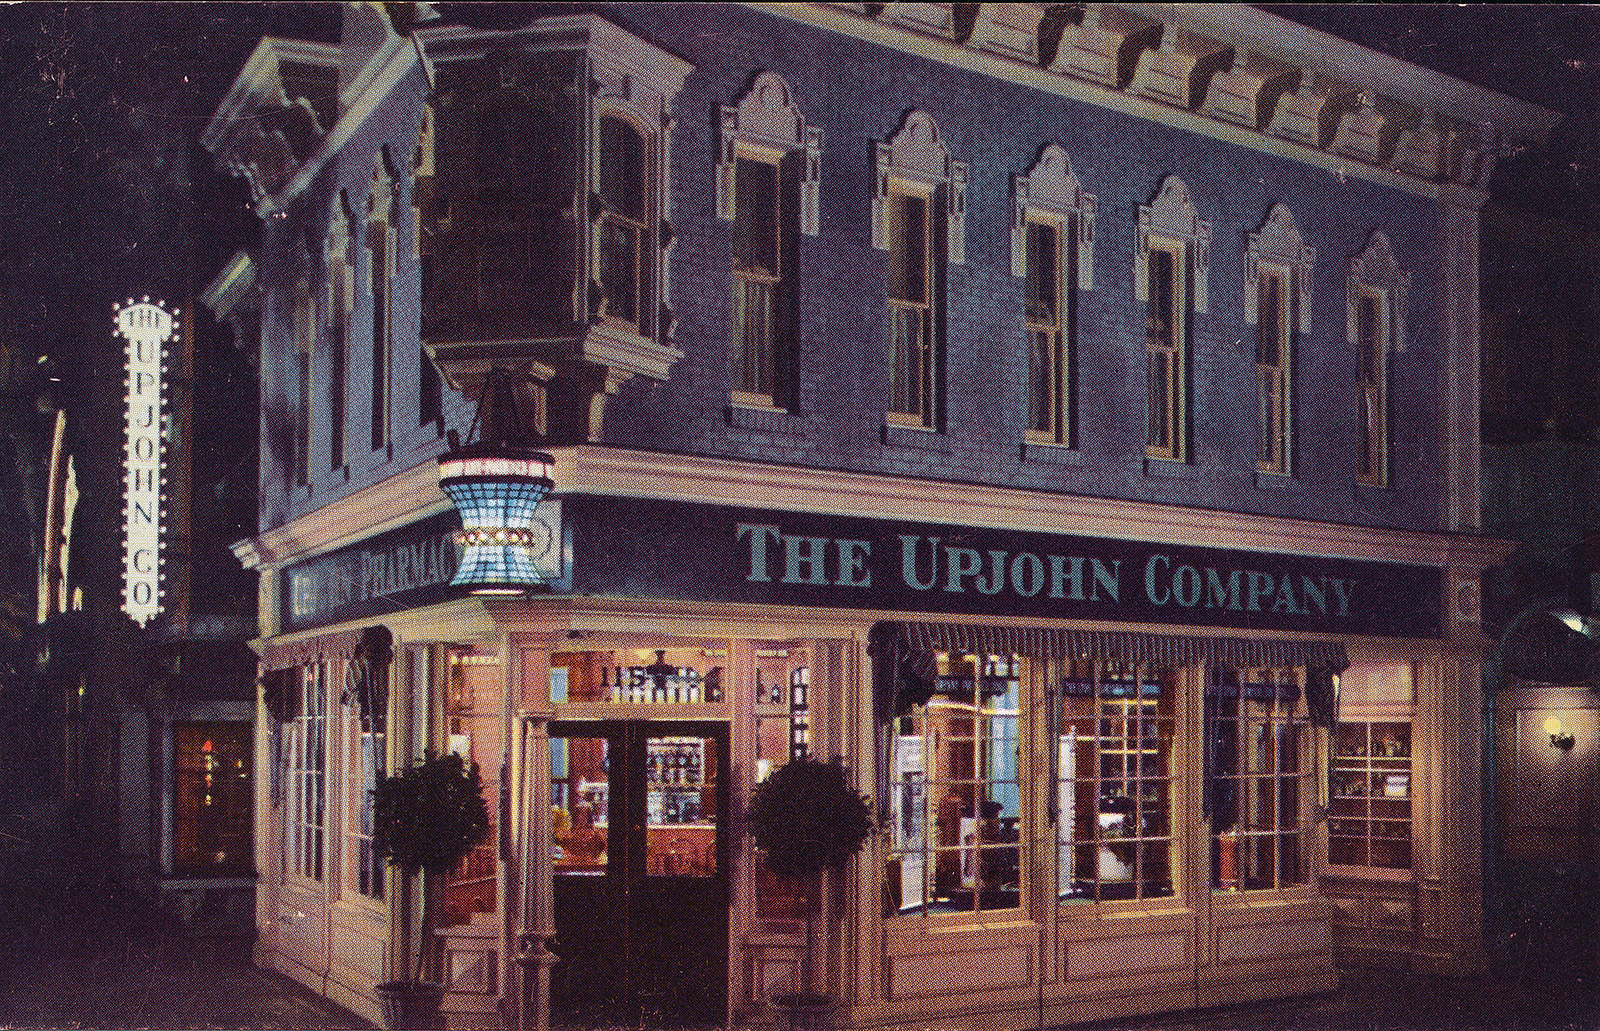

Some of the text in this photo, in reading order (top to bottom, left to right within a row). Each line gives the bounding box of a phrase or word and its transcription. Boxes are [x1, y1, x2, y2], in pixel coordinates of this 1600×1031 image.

[125, 307, 164, 328] THE
[132, 338, 155, 605] UPJOHN CO
[360, 533, 453, 602] PHARMAC
[735, 522, 1357, 618] THE UPJOHN COMPANY
